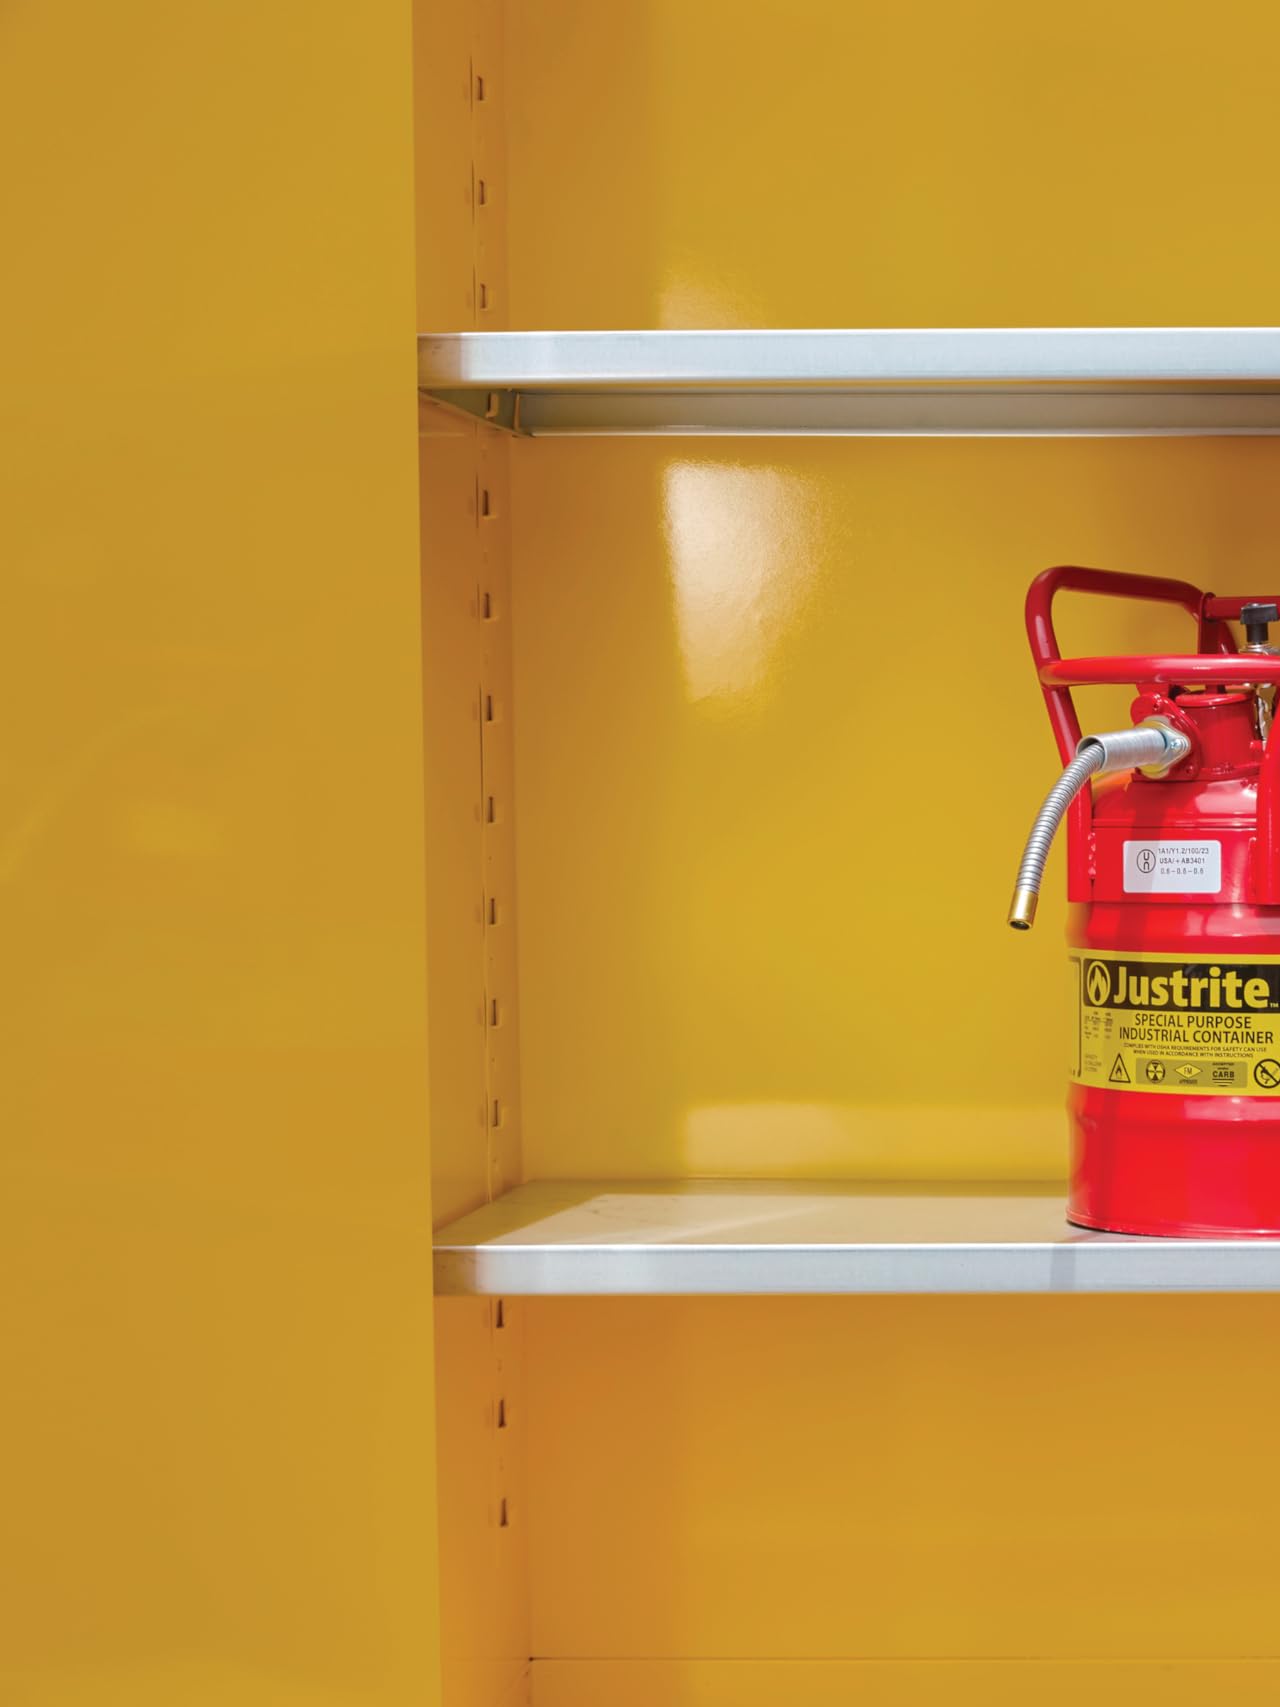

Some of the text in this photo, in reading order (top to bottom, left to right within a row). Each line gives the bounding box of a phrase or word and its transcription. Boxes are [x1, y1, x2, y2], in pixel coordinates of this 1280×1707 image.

[1135, 1012, 1252, 1029] SPECIAL PURPOSE
[1119, 1026, 1274, 1044] INDUSTRIAL CONTAINER
[1212, 1070, 1235, 1078] CARB
